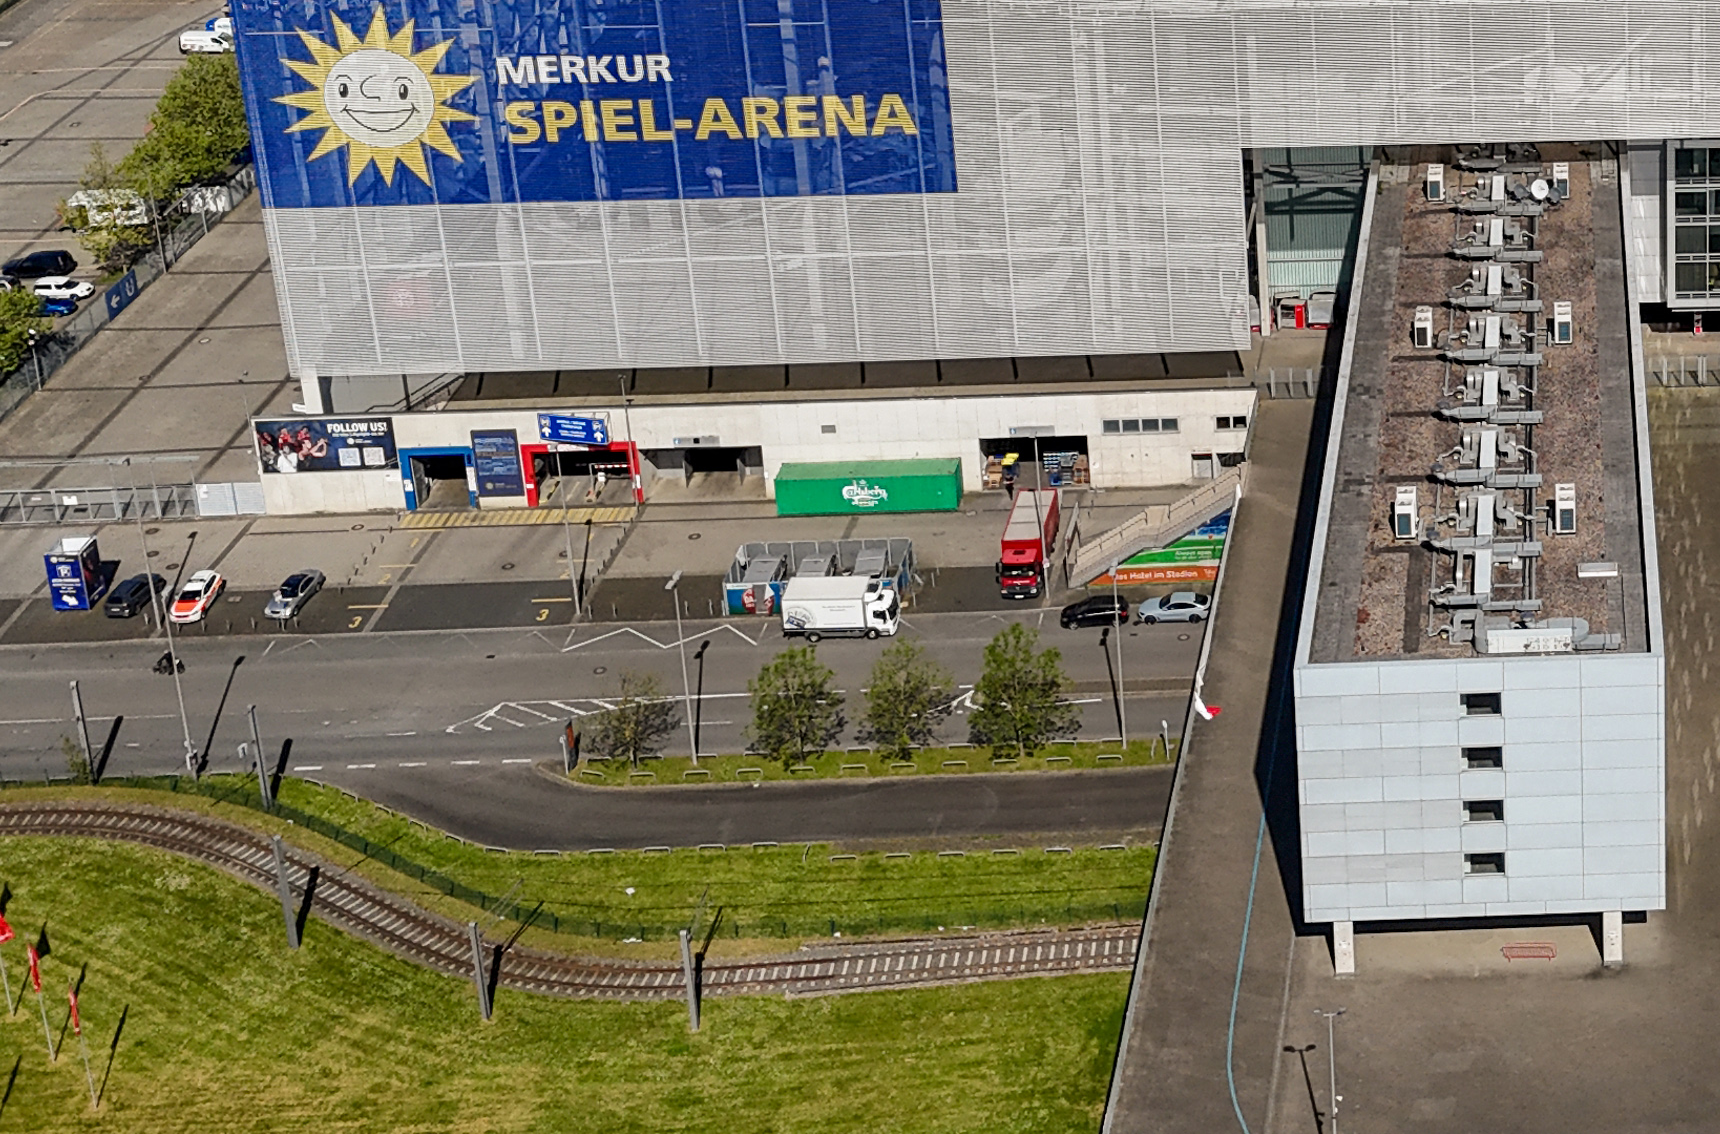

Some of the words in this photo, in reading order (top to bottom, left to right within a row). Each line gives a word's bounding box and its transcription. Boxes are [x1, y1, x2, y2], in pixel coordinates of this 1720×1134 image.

[495, 54, 674, 84] MERKUR
[507, 92, 919, 145] SPIEL-ARENA
[326, 422, 368, 433] FOLLOW
[369, 422, 388, 432] US!
[1166, 570, 1198, 578] Stadion
[348, 615, 362, 629] 3
